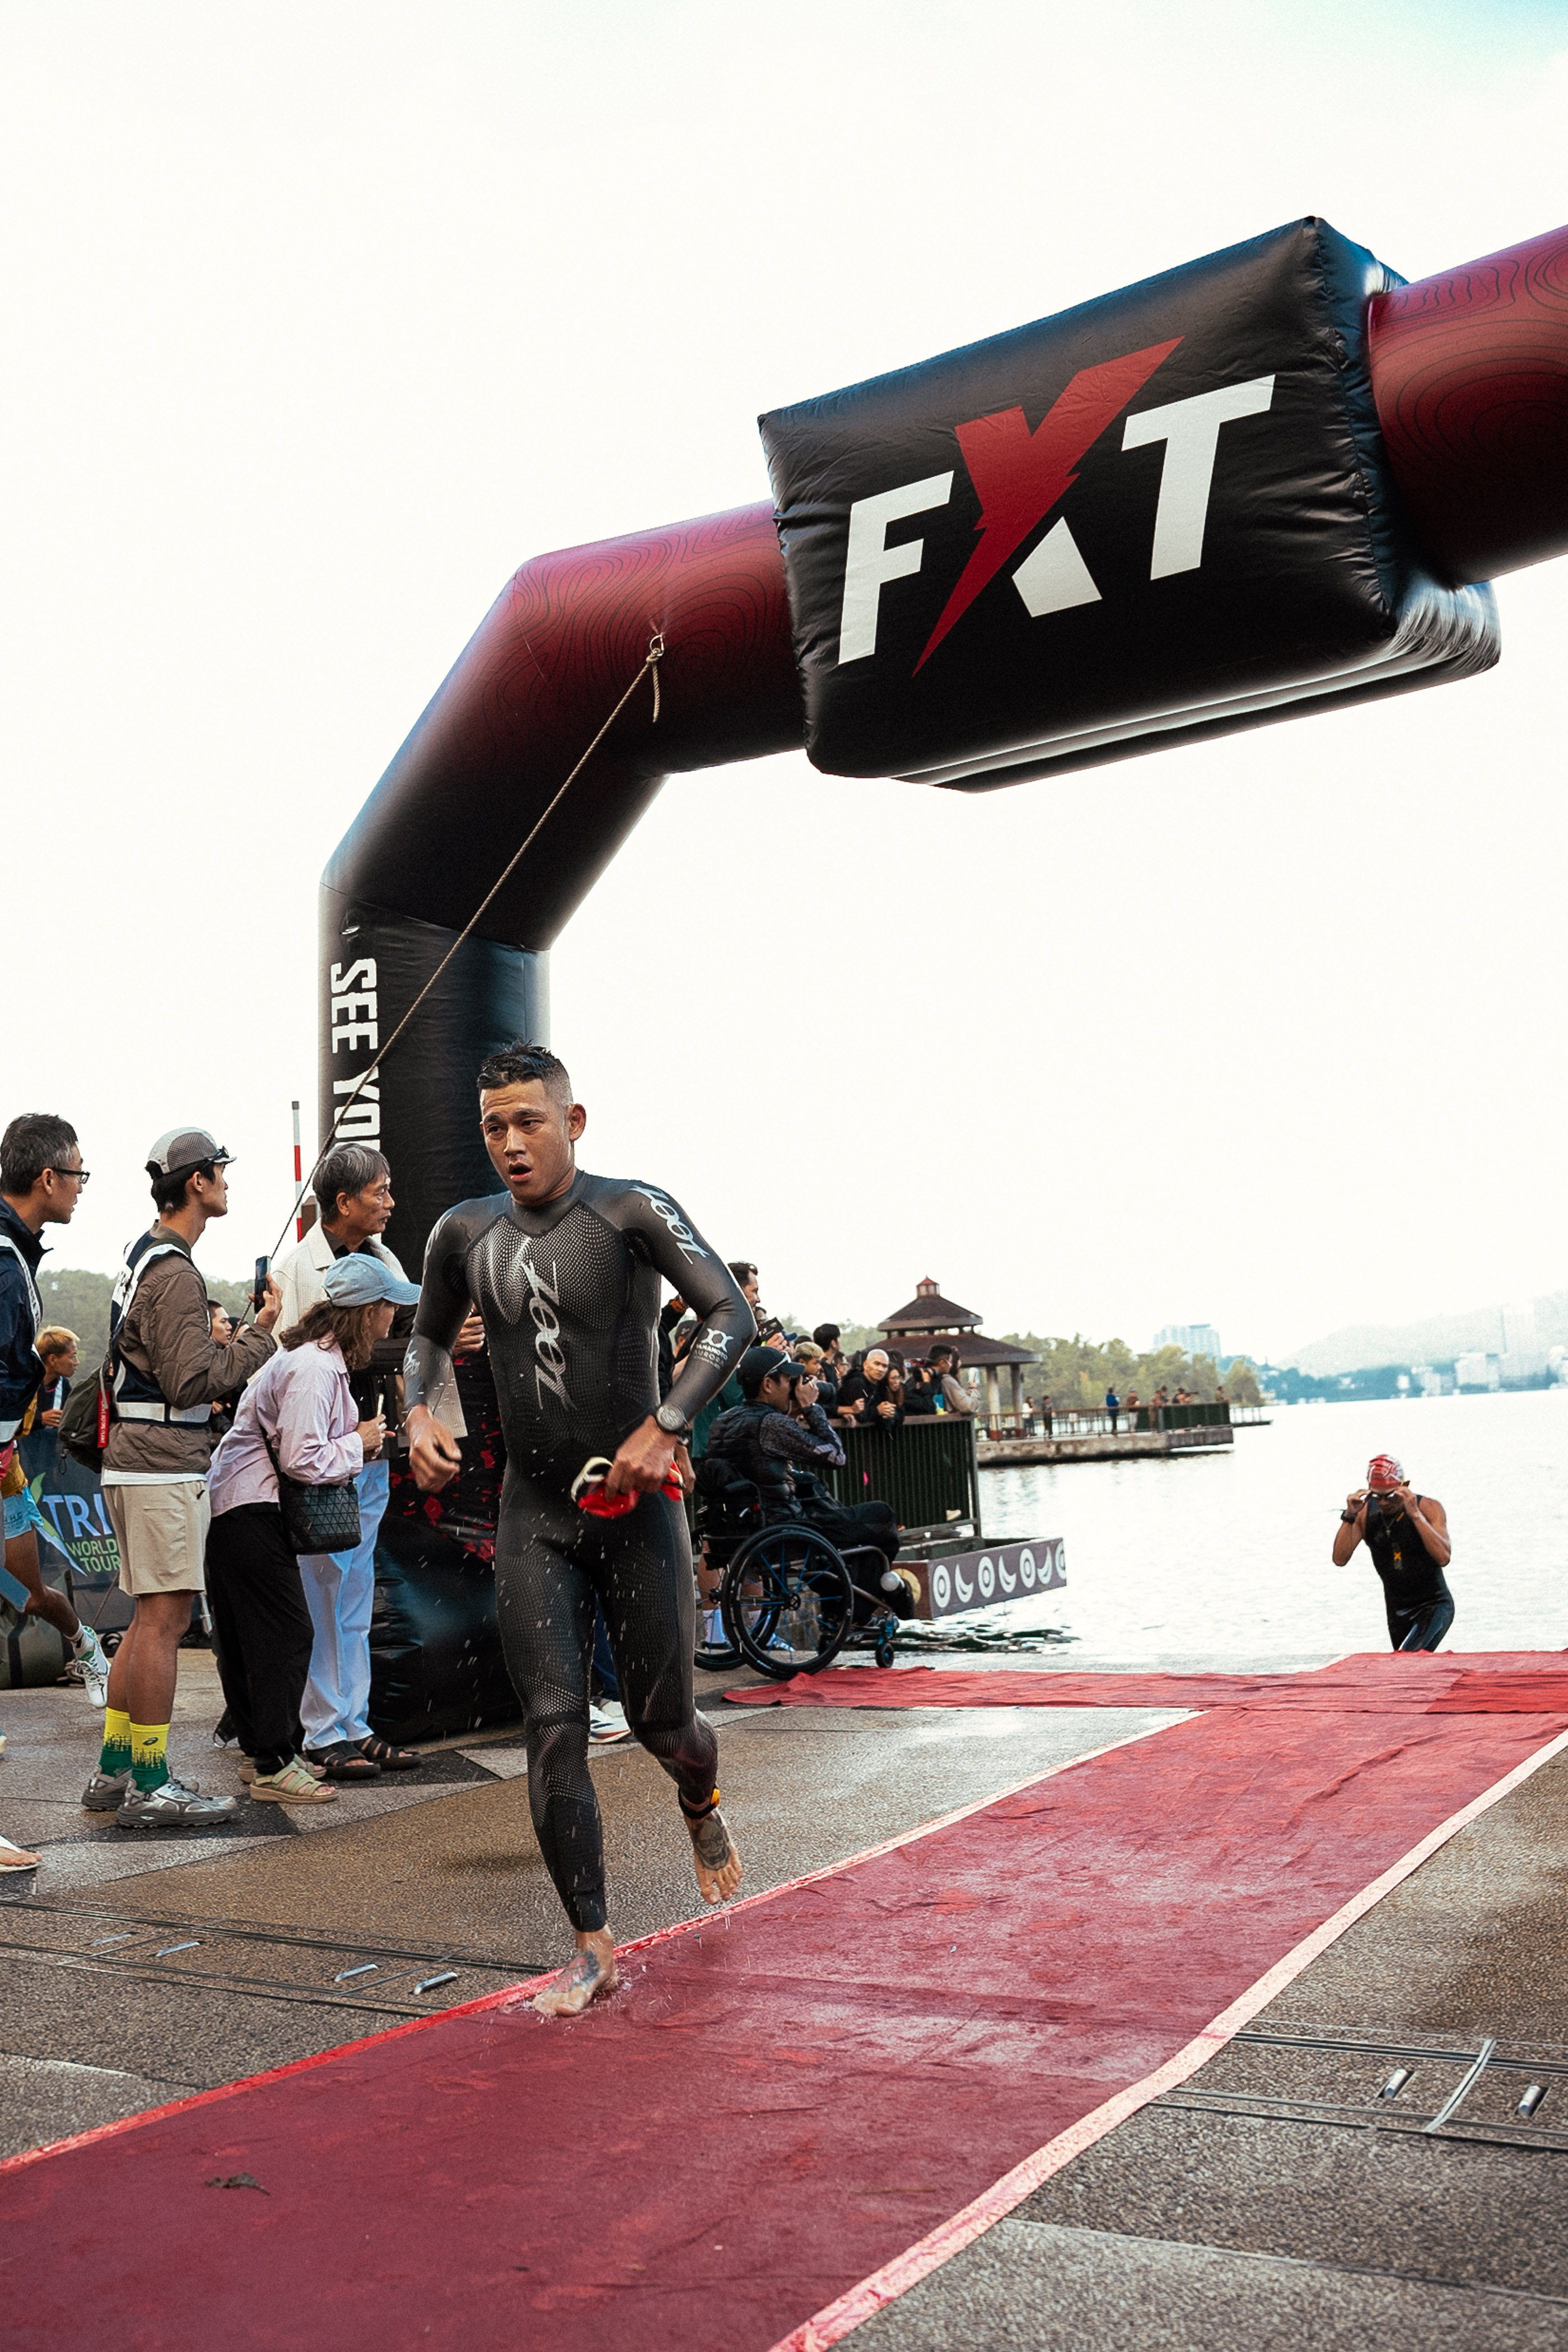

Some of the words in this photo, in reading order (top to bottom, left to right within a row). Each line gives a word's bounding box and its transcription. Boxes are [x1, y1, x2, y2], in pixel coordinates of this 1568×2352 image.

[838, 335, 1276, 679] FXT
[330, 958, 378, 1053] SEE
[333, 1066, 381, 1152] YO
[65, 1538, 118, 1557] WORLD
[80, 1555, 121, 1572] TOUR
